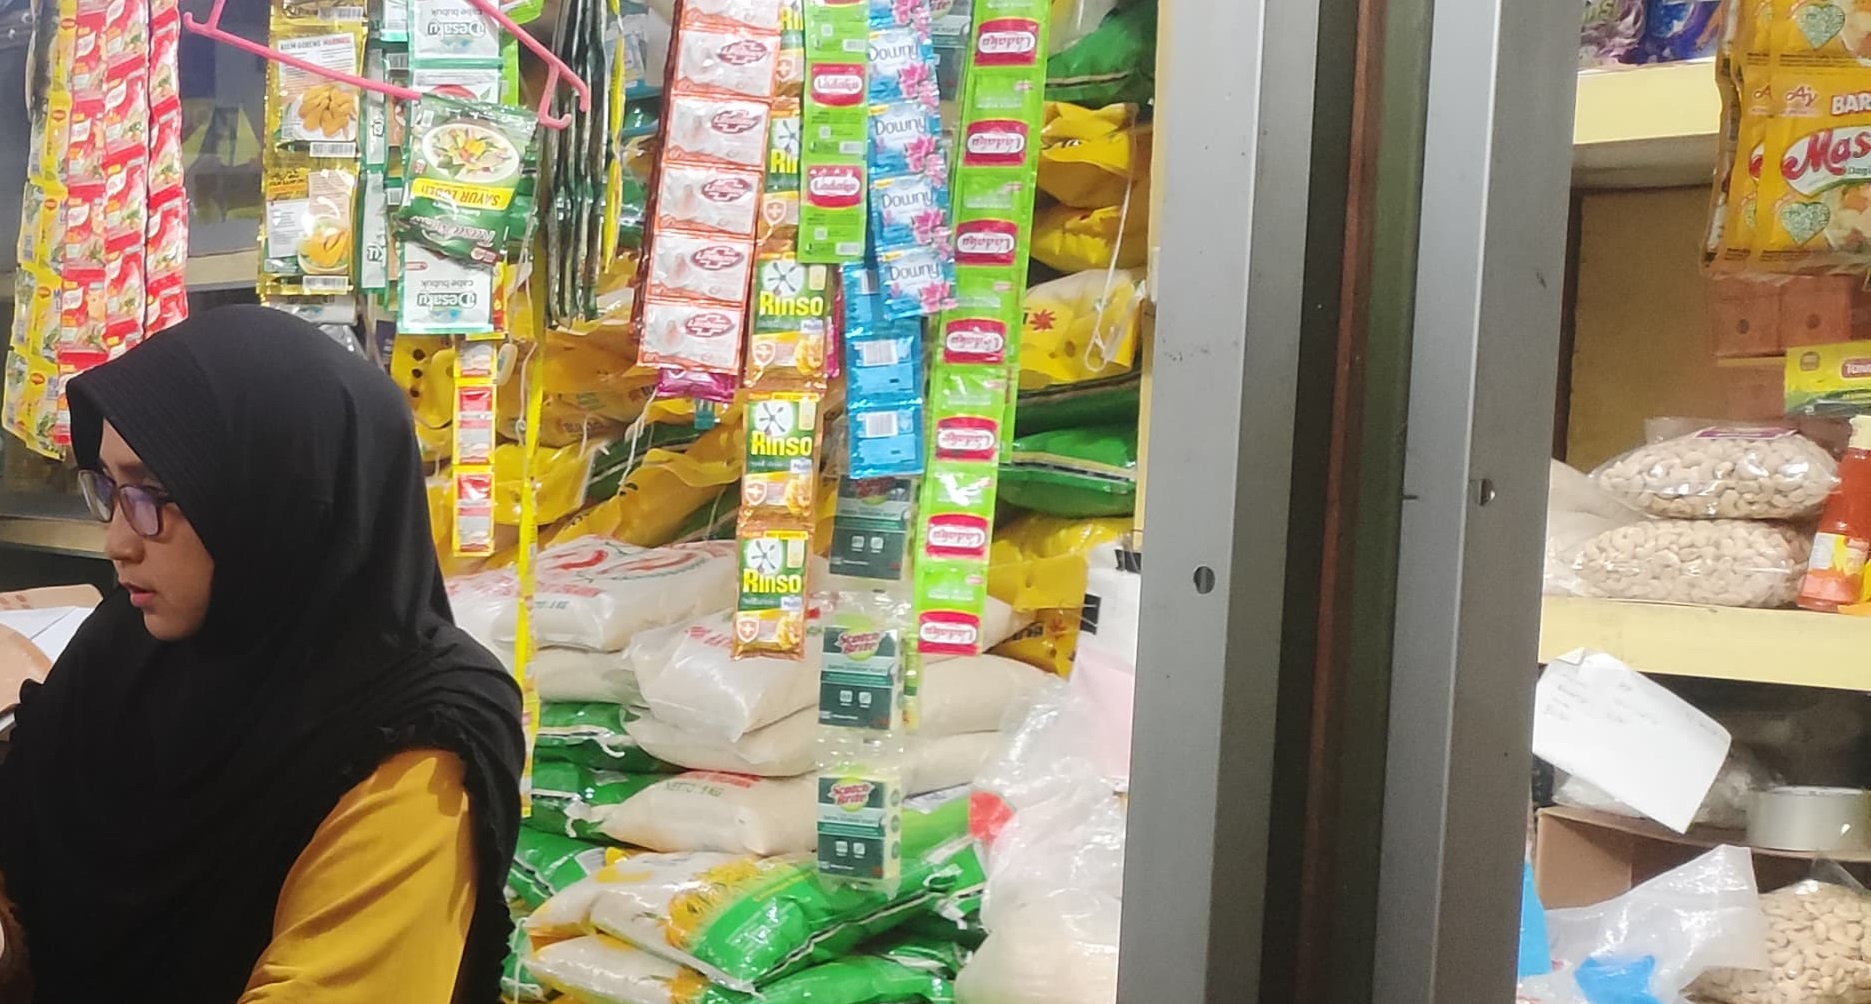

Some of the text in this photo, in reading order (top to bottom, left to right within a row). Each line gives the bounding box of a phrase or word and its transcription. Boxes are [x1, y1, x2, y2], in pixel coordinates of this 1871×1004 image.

[427, 21, 486, 39] Desaku
[869, 43, 919, 64] Downy
[875, 117, 926, 140] Downy
[882, 189, 934, 209] Downy
[889, 262, 940, 281] Downy
[416, 291, 477, 310] Desaku
[759, 290, 824, 316] Rinso
[750, 430, 813, 456] Rinso
[742, 568, 802, 594] Rinso
